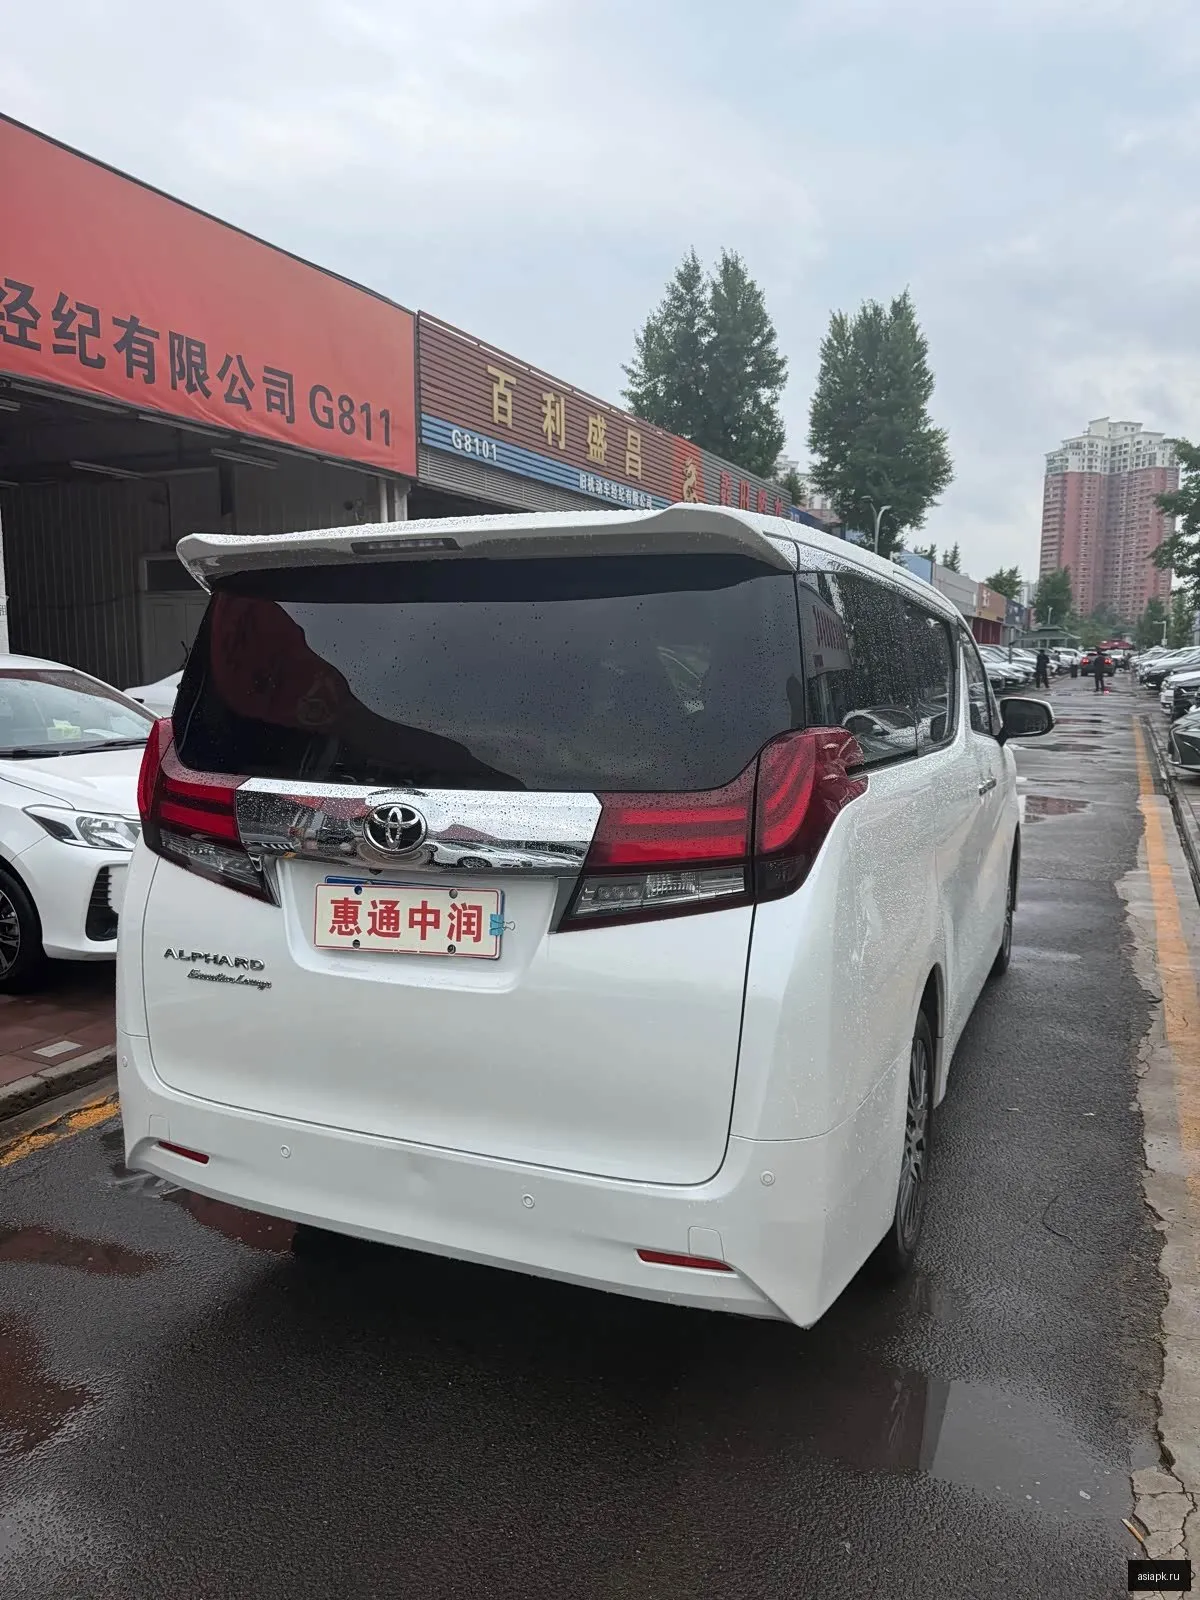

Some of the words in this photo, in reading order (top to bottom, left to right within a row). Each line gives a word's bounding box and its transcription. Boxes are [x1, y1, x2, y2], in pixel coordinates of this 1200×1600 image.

[0, 277, 296, 424] 经纪有限公司
[308, 383, 392, 447] G811
[486, 364, 643, 481] 百利盛昌
[451, 428, 498, 462] G8101
[579, 472, 652, 510] 旧机动车经纪有限公司
[329, 896, 484, 943] 惠通中润
[163, 947, 266, 971] ALPHARD
